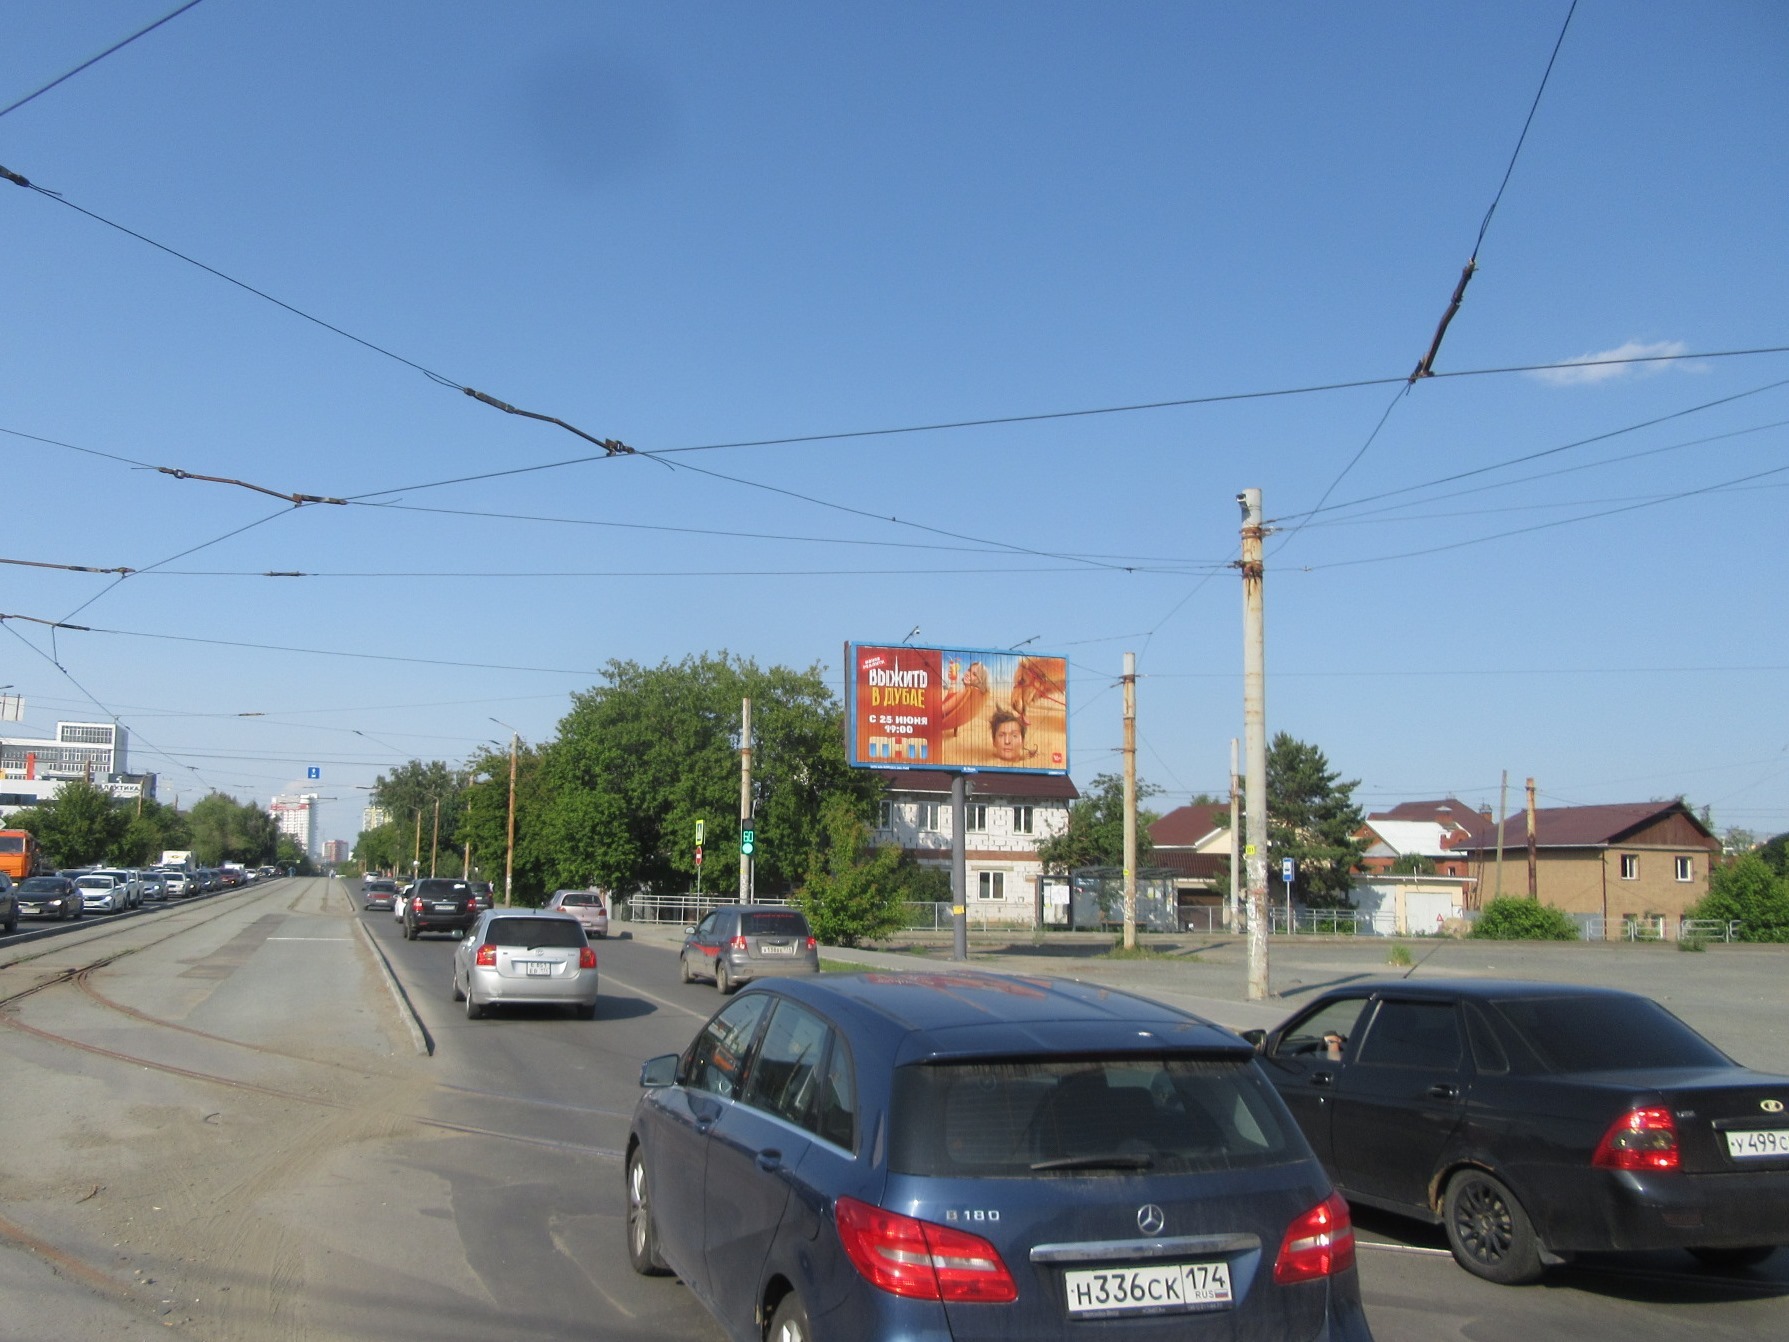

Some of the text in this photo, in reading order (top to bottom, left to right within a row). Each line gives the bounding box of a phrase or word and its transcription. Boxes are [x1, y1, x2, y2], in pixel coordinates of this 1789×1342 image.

[869, 655, 928, 689] ВЫЖИТЬ
[872, 686, 925, 708] В ДУБАЕ
[869, 714, 928, 725] С 25 ИЮНЯ
[884, 725, 914, 734] 19:00
[869, 736, 928, 760] ТНТ
[743, 830, 754, 843] 60
[964, 1210, 1000, 1221] 180
[1185, 1265, 1226, 1290] 174
[1195, 1288, 1215, 1300] RUS
